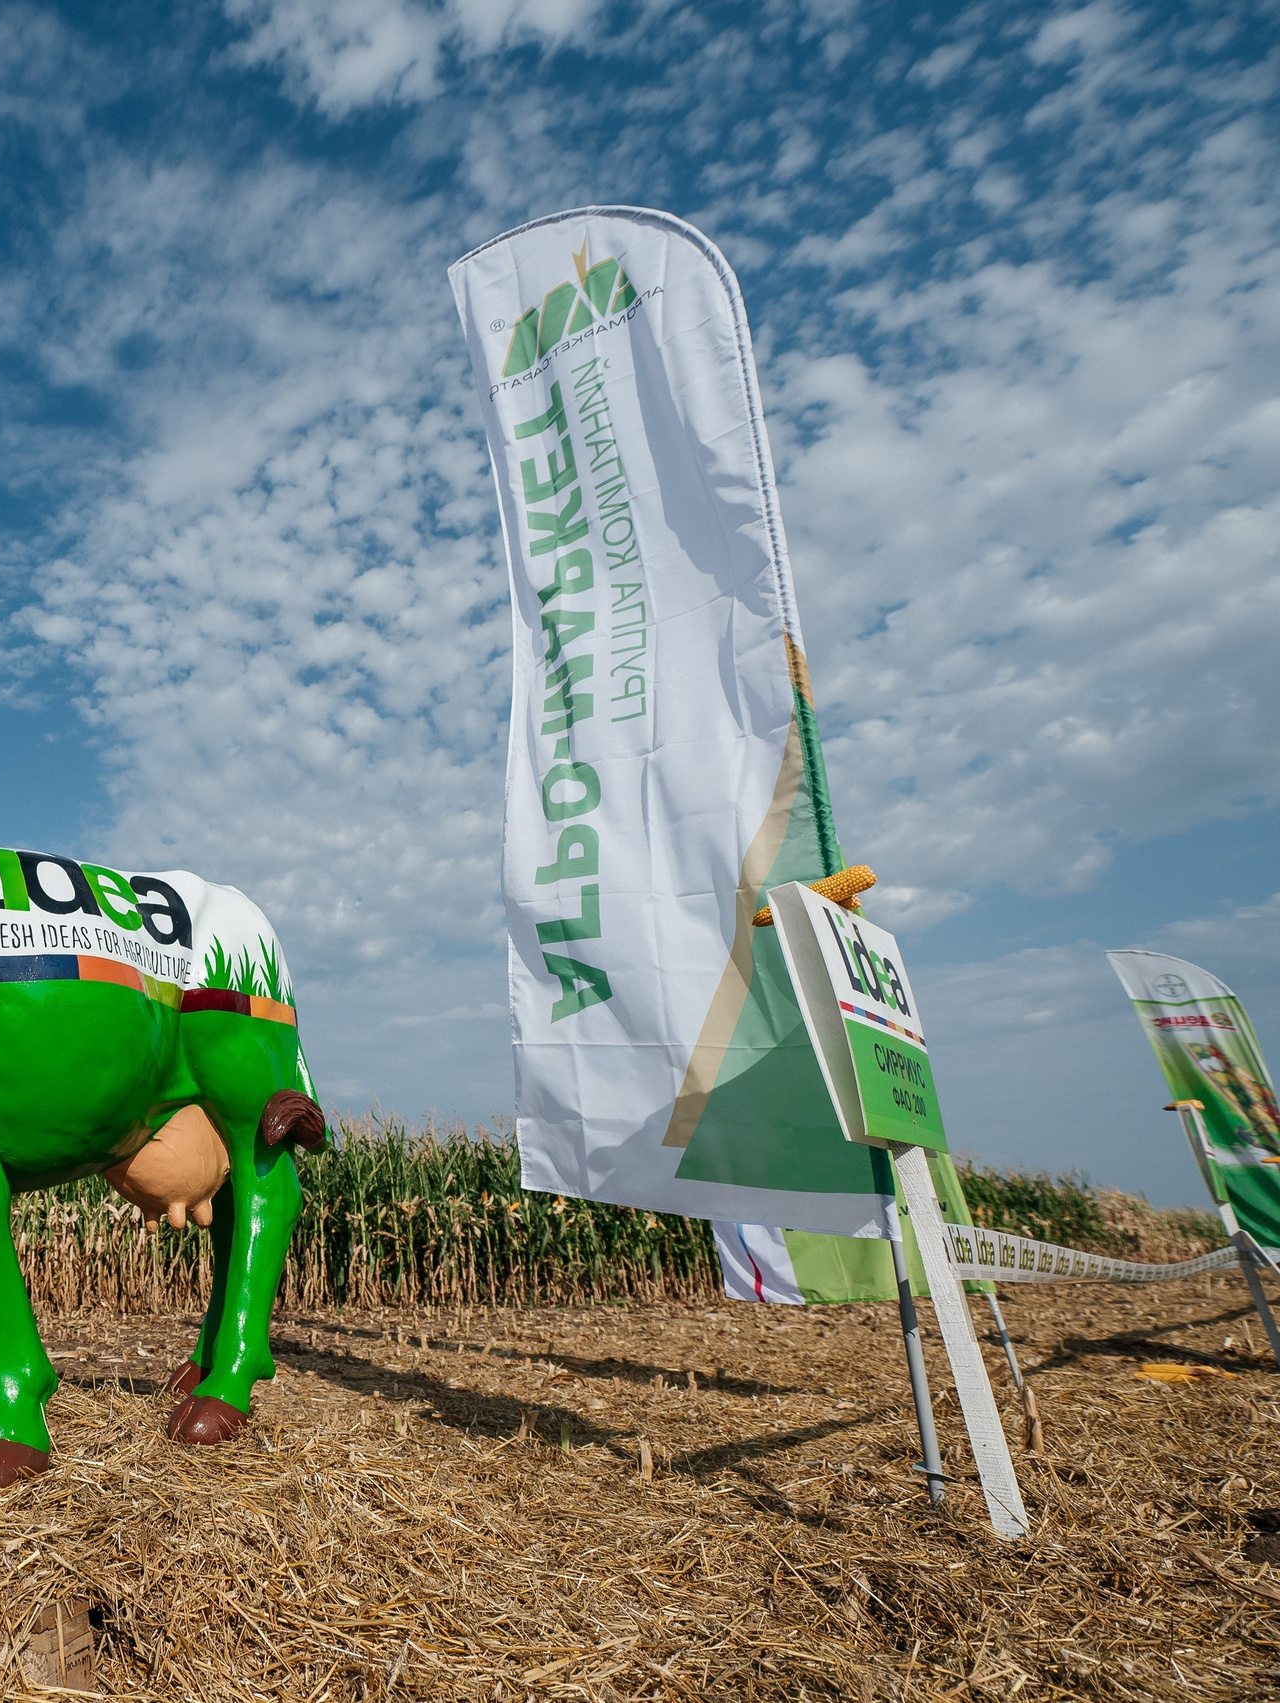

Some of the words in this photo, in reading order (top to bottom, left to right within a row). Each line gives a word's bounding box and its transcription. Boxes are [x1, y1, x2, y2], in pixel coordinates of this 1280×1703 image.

[41, 923, 92, 950] IDEAS
[94, 927, 123, 957] FOR
[122, 937, 192, 985] AGRICULTURE
[822, 905, 912, 1018] Lidea
[874, 1043, 926, 1089] СИРРИУС
[892, 1086, 912, 1112] ФАО
